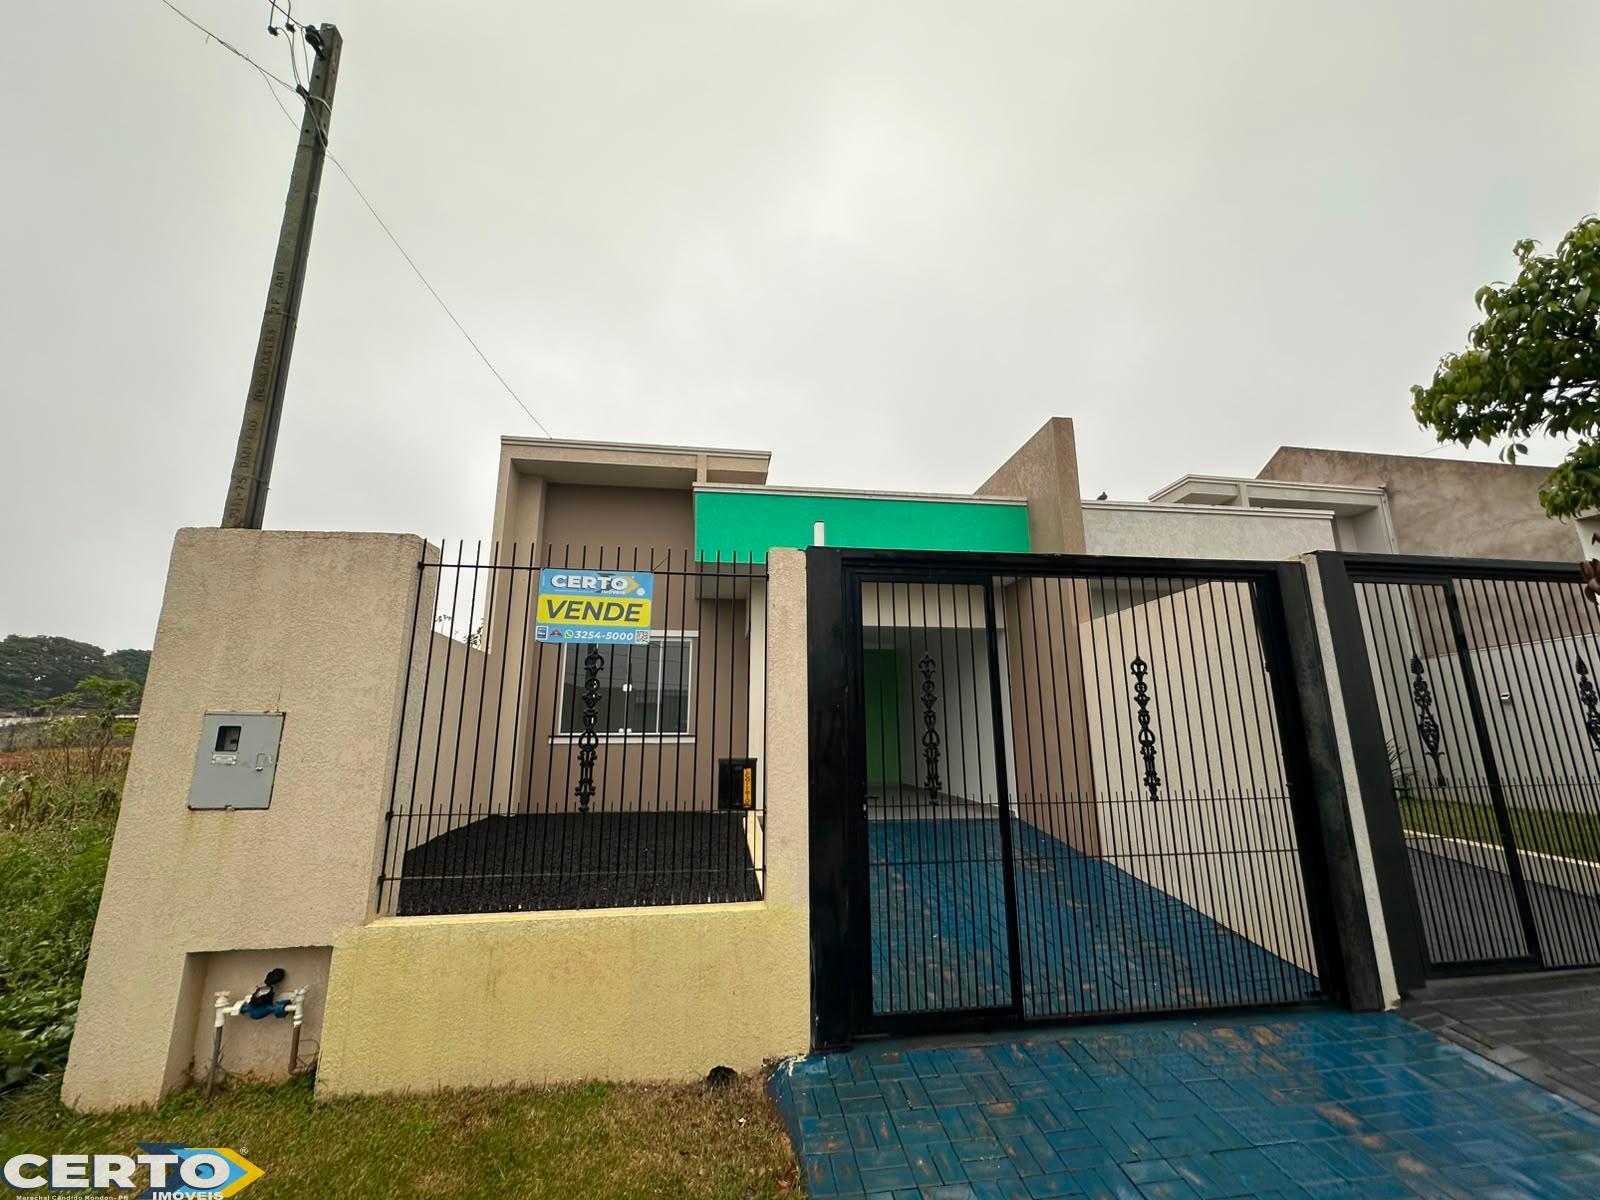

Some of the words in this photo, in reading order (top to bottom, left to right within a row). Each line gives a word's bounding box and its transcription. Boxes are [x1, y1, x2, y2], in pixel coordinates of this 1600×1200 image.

[551, 574, 629, 591] CERTO
[547, 599, 643, 622] VENDE
[574, 630, 634, 641] 3254-5000
